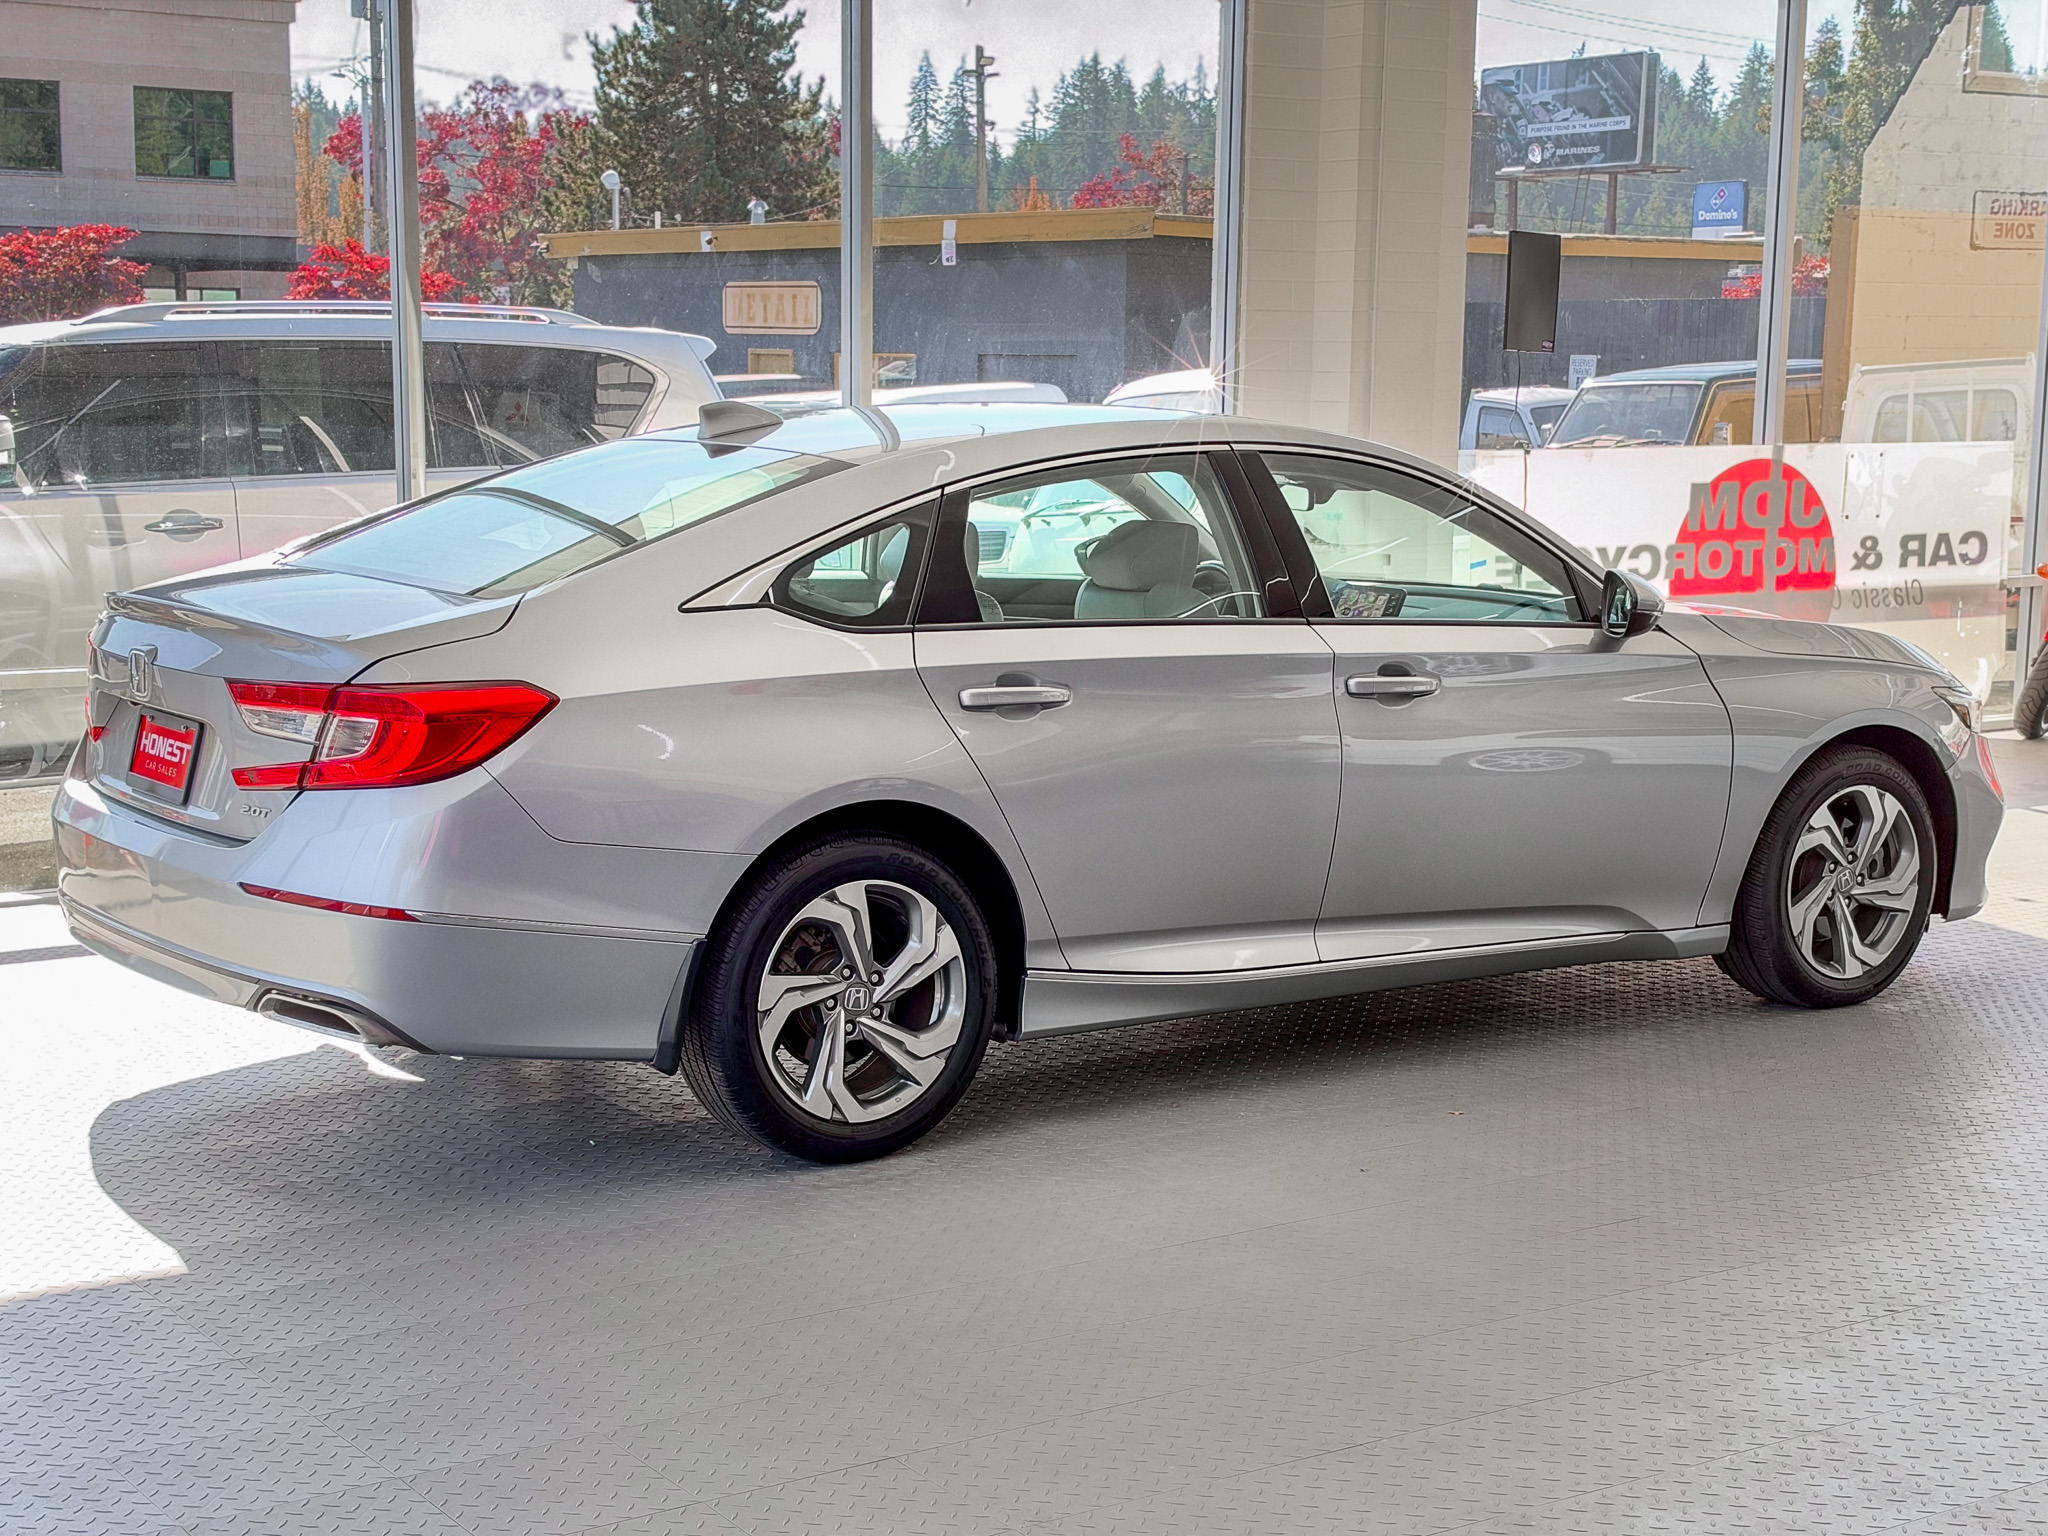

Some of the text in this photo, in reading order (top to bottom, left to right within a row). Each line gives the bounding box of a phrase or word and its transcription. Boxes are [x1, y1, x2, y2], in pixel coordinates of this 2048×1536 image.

[1530, 126, 1553, 134] PURPOSE
[1577, 122, 1587, 130] THE
[1588, 121, 1608, 129] MARINE
[1608, 119, 1627, 128] CORPS
[1555, 145, 1601, 156] MARINES
[1698, 208, 1738, 221] Domino's
[732, 292, 814, 325] DETAIL
[1571, 358, 1595, 368] RESERVED
[1572, 367, 1592, 377] PARKING
[140, 730, 192, 765] HONEST
[144, 759, 177, 778] CAR SALES
